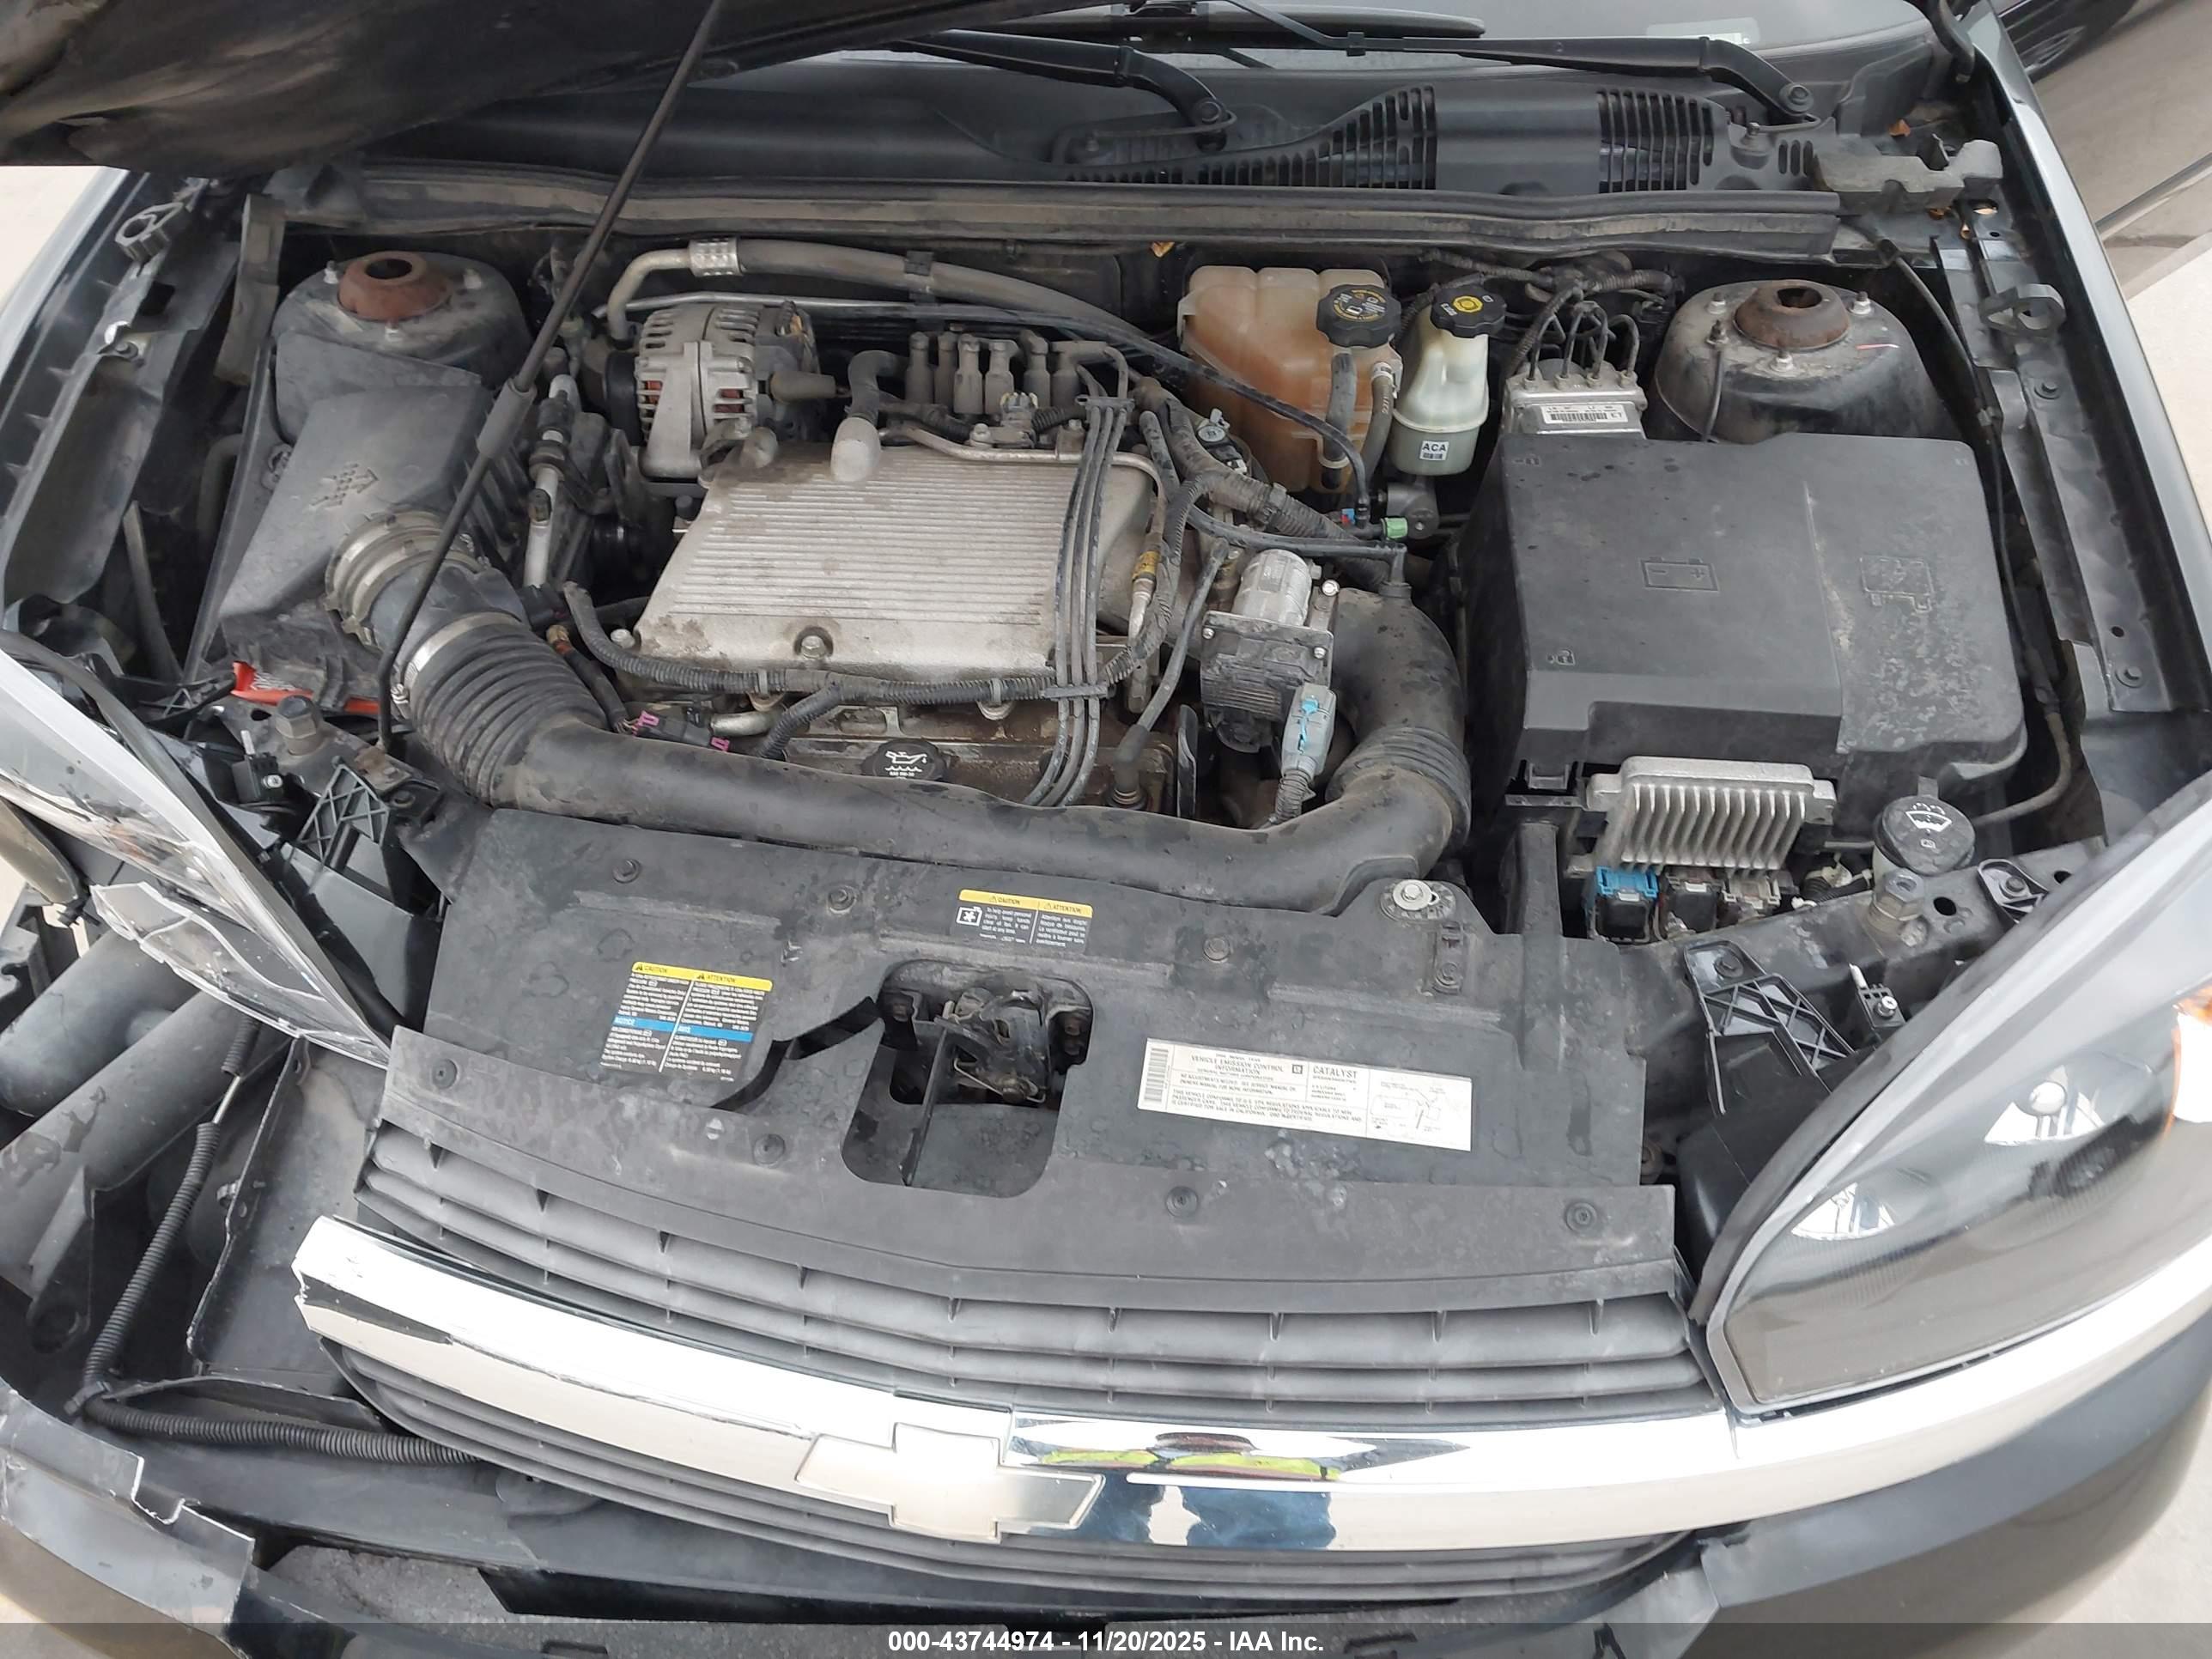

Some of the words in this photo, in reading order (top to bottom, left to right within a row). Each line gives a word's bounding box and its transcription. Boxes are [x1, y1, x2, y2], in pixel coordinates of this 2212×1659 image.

[1423, 443, 1446, 452] ACA
[1053, 904, 1082, 913] ATTENTION
[707, 974, 736, 983] ATTENTION
[1220, 1059, 1252, 1068] EMISSION
[1253, 1062, 1285, 1073] CONTROL
[1313, 1065, 1358, 1079] CATALYST
